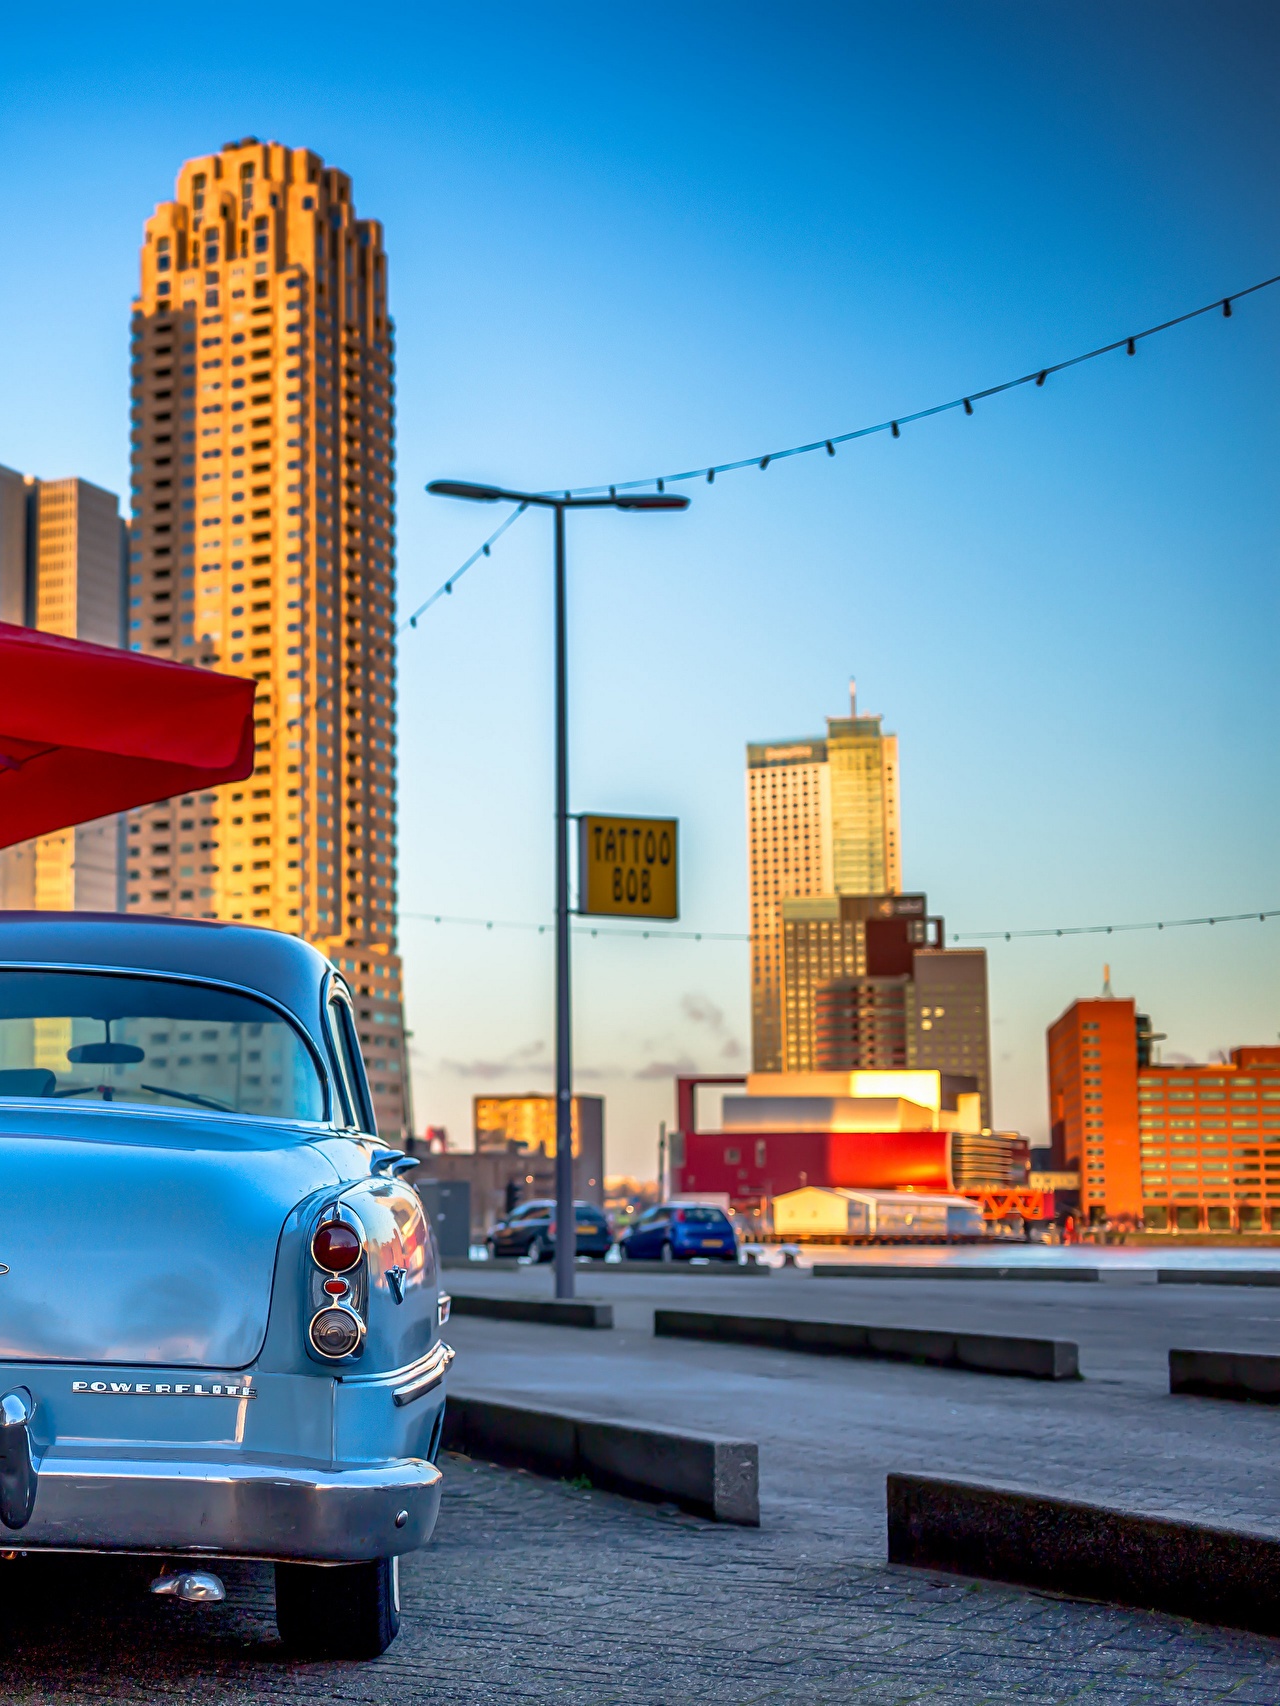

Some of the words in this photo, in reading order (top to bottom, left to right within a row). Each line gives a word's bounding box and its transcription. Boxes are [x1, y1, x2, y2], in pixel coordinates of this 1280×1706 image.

[594, 826, 671, 866] TATTOO
[613, 866, 652, 904] BOB
[72, 1381, 257, 1396] POWERFLITE
